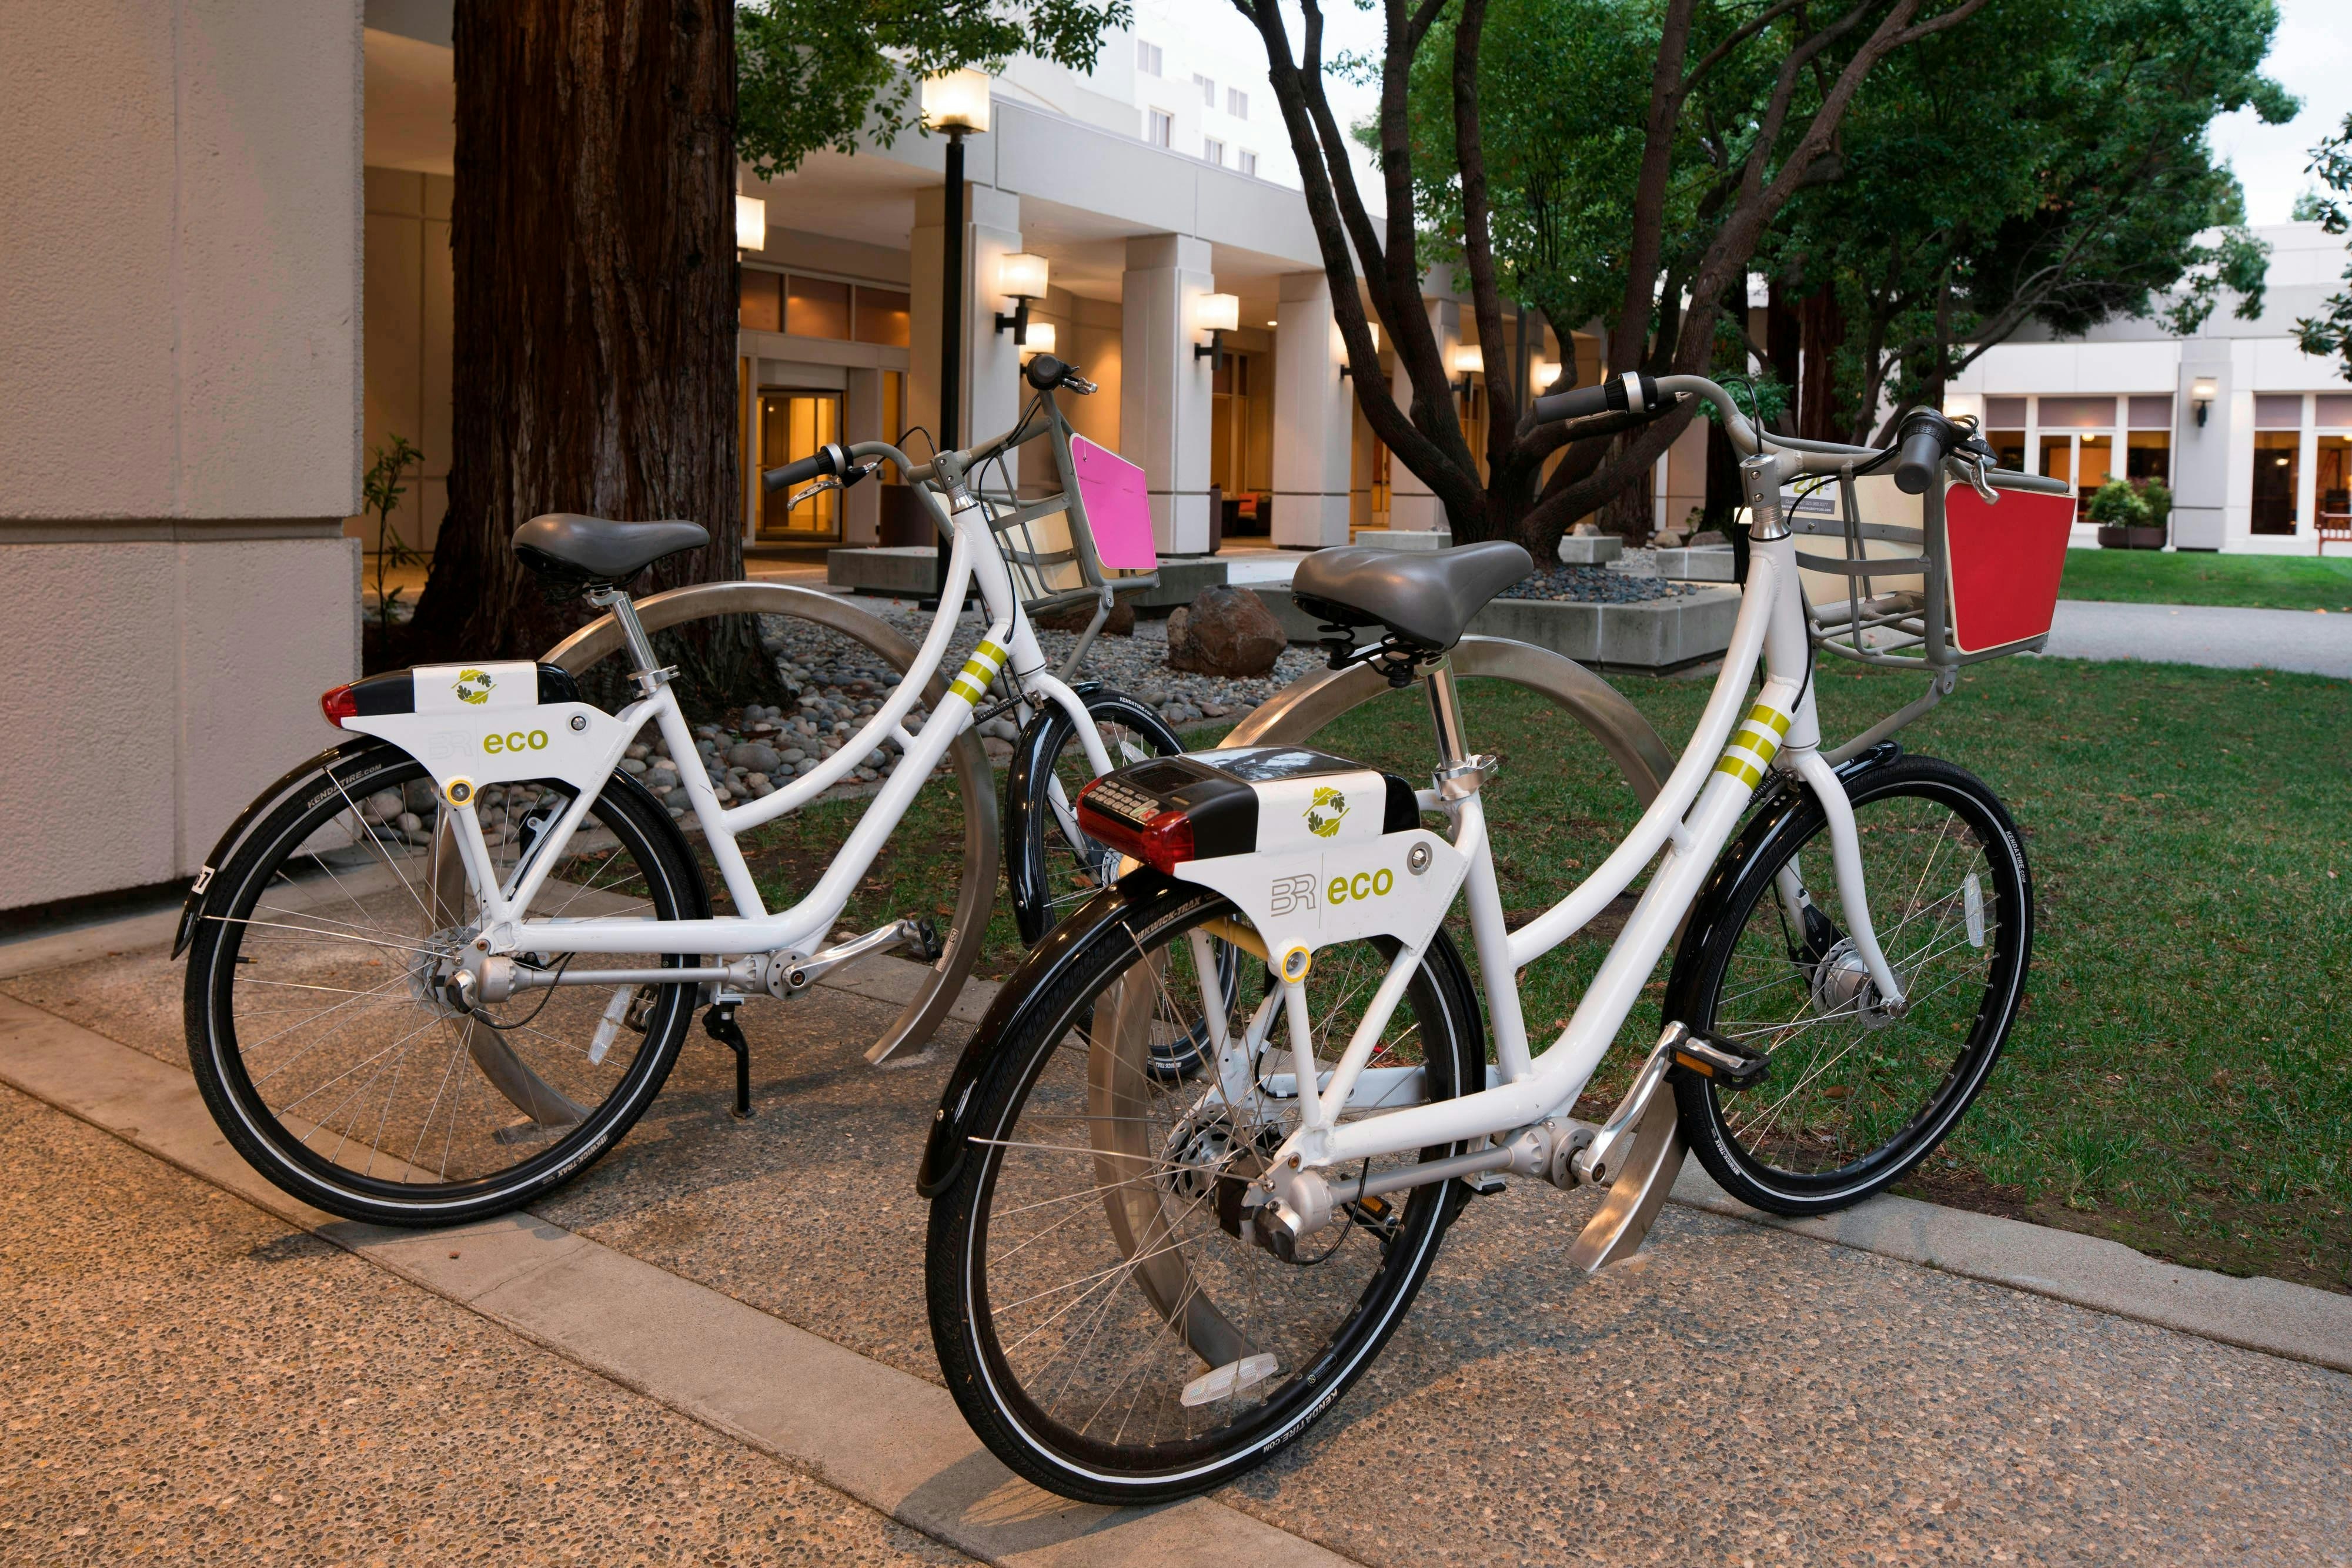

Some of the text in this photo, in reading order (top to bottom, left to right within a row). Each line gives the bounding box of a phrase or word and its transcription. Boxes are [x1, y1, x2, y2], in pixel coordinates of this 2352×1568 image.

[1793, 472, 1823, 495] 24
[1120, 697, 1152, 717] KENDATIRE.COM
[483, 730, 549, 754] eco
[307, 764, 382, 809] KENDATIRE.COM
[2005, 830, 2026, 883] KENDATIRE.COM
[1271, 868, 1394, 917] BR eco
[1263, 1387, 1338, 1454] KENDATIRE.COM
